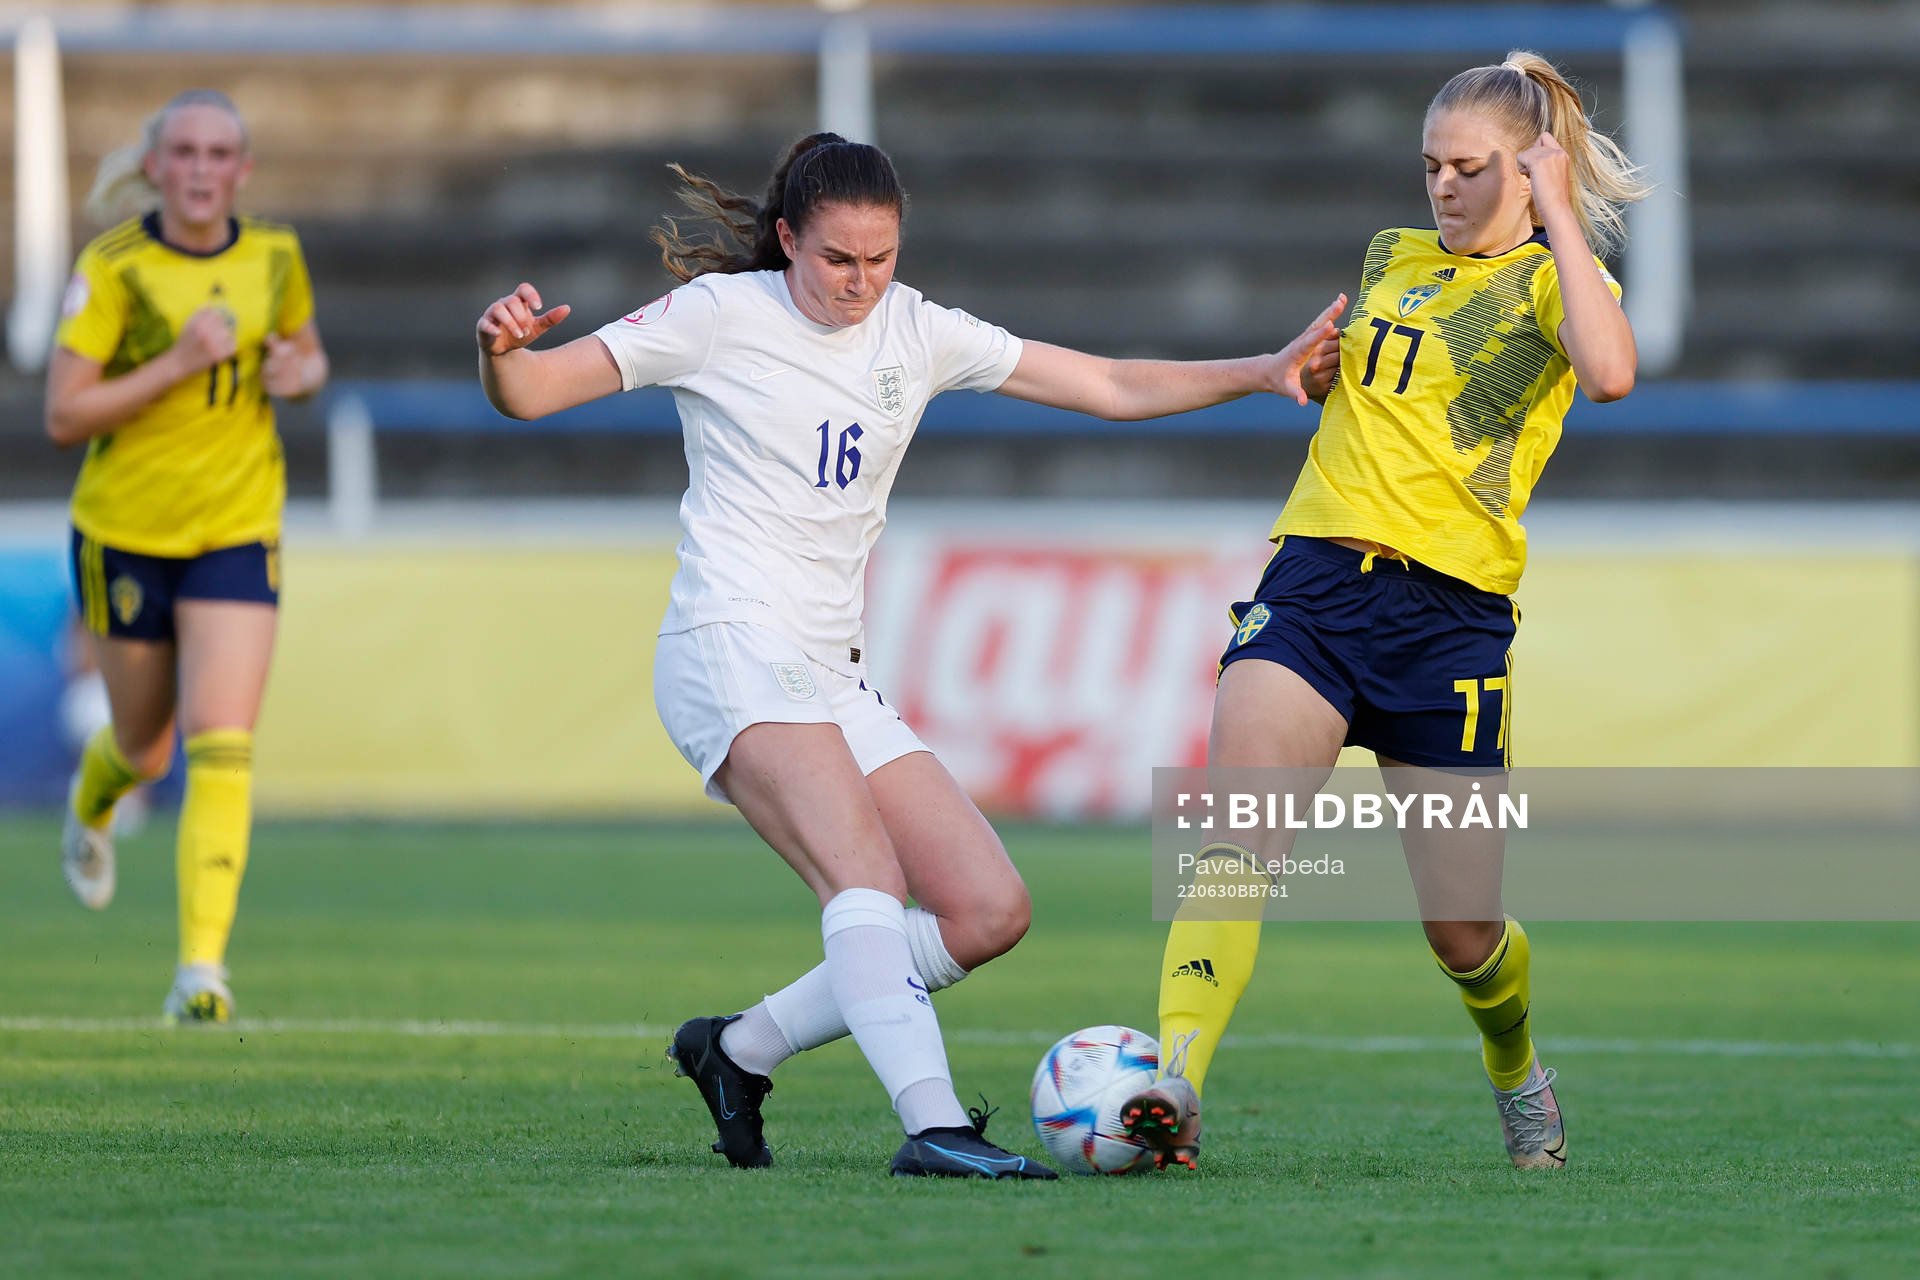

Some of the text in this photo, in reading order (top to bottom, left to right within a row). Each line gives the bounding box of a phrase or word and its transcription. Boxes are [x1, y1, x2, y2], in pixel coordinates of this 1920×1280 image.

[1361, 317, 1425, 395] 17
[814, 419, 864, 490] 16
[1454, 676, 1508, 752] 17
[1171, 968, 1219, 988] adidas
